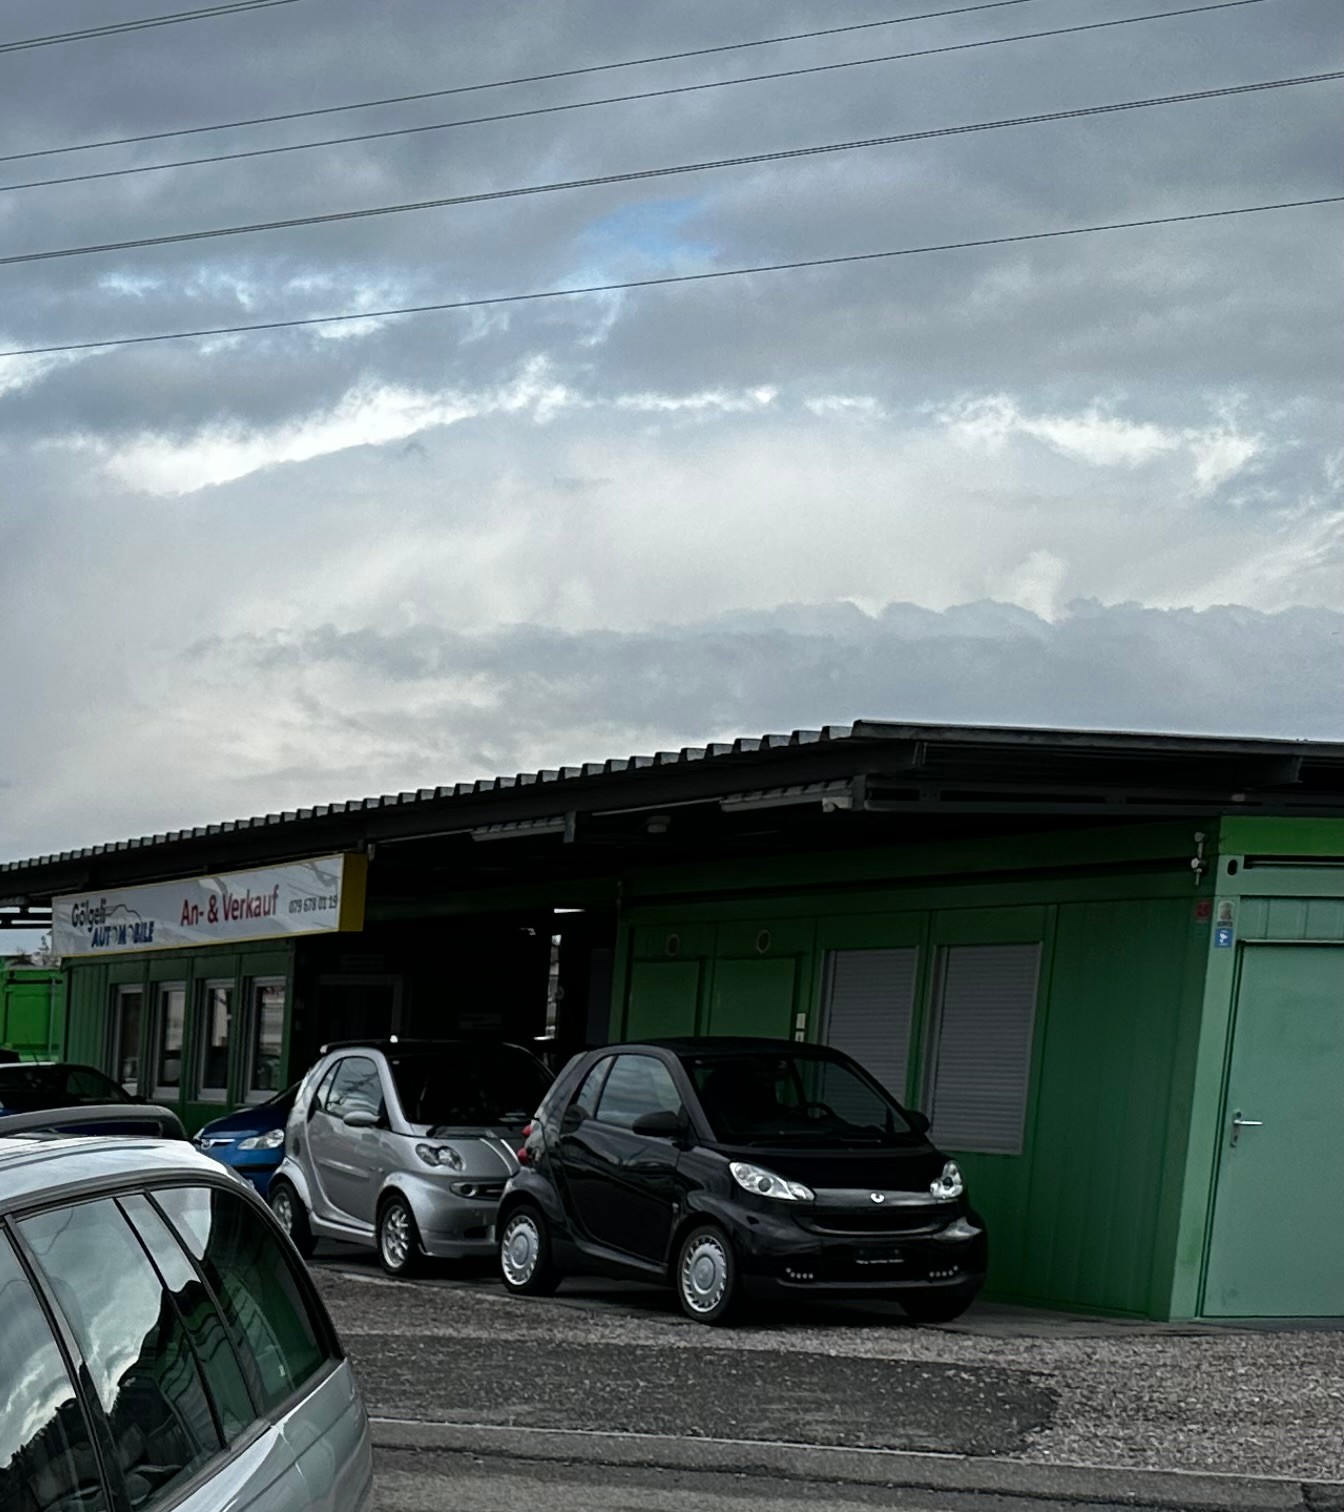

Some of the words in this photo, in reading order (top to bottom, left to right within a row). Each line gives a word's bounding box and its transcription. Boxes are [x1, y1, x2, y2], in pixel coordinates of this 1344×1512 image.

[180, 898, 204, 927] An-
[207, 894, 219, 924] &
[222, 884, 280, 922] Verkauf
